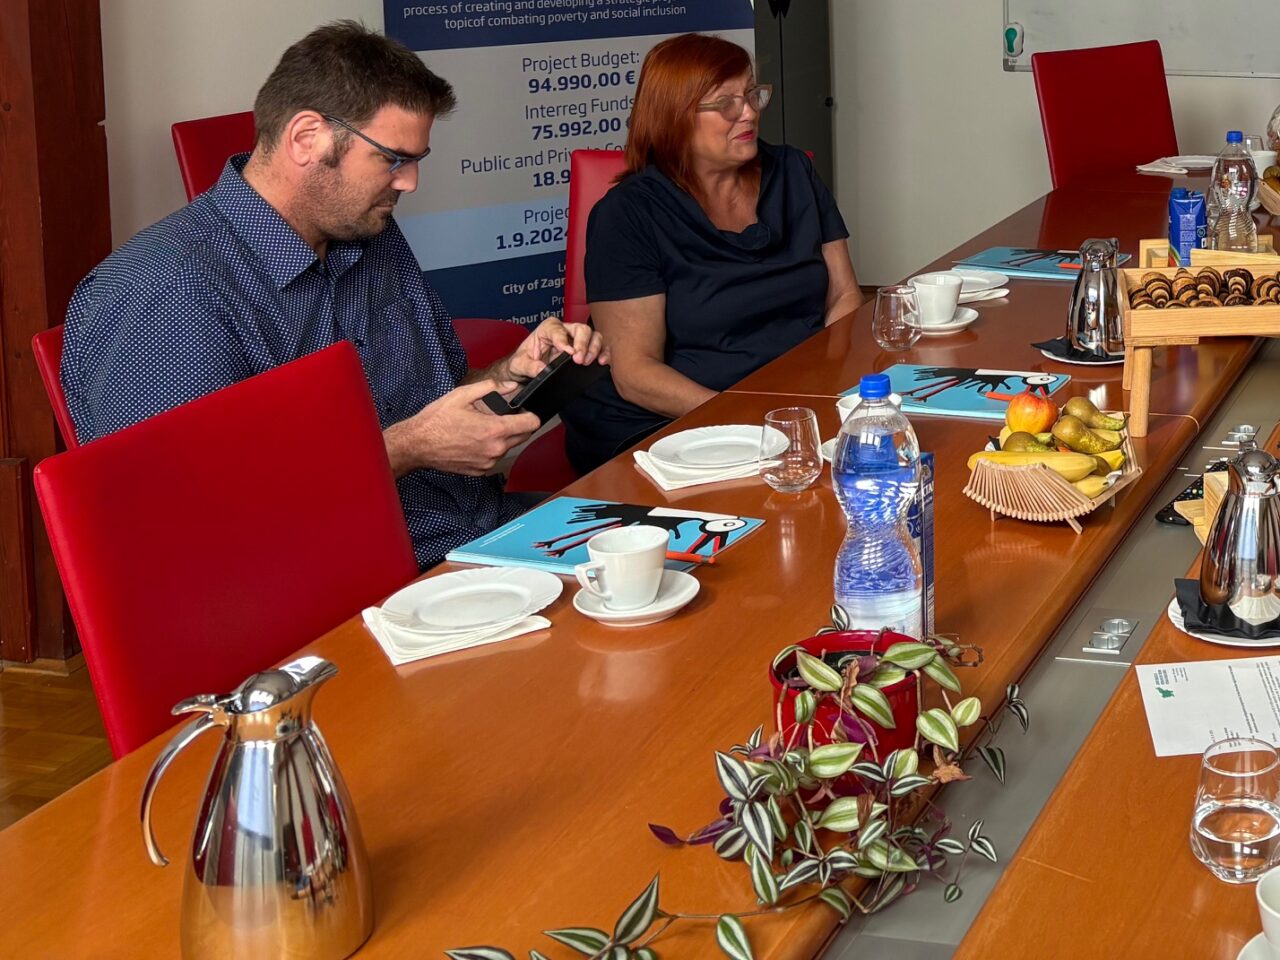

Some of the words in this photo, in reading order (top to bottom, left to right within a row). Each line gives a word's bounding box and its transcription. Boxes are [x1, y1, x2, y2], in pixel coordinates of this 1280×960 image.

[403, 4, 448, 19] process
[450, 1, 463, 14] of
[465, 0, 512, 12] creating
[445, 15, 485, 30] topicof
[487, 13, 546, 26] combating
[548, 10, 588, 24] poverty
[590, 9, 609, 20] and
[611, 7, 641, 19] social
[642, 4, 687, 17] inclusion
[522, 55, 577, 74] Project
[581, 50, 640, 69] Budget:
[528, 72, 620, 94] 94.990,00
[625, 70, 635, 85] €
[525, 102, 587, 120] Interreg
[532, 117, 621, 141] 75.992,00
[461, 155, 511, 174] Public
[515, 150, 544, 168] and
[502, 283, 525, 295] City
[527, 279, 540, 291] of
